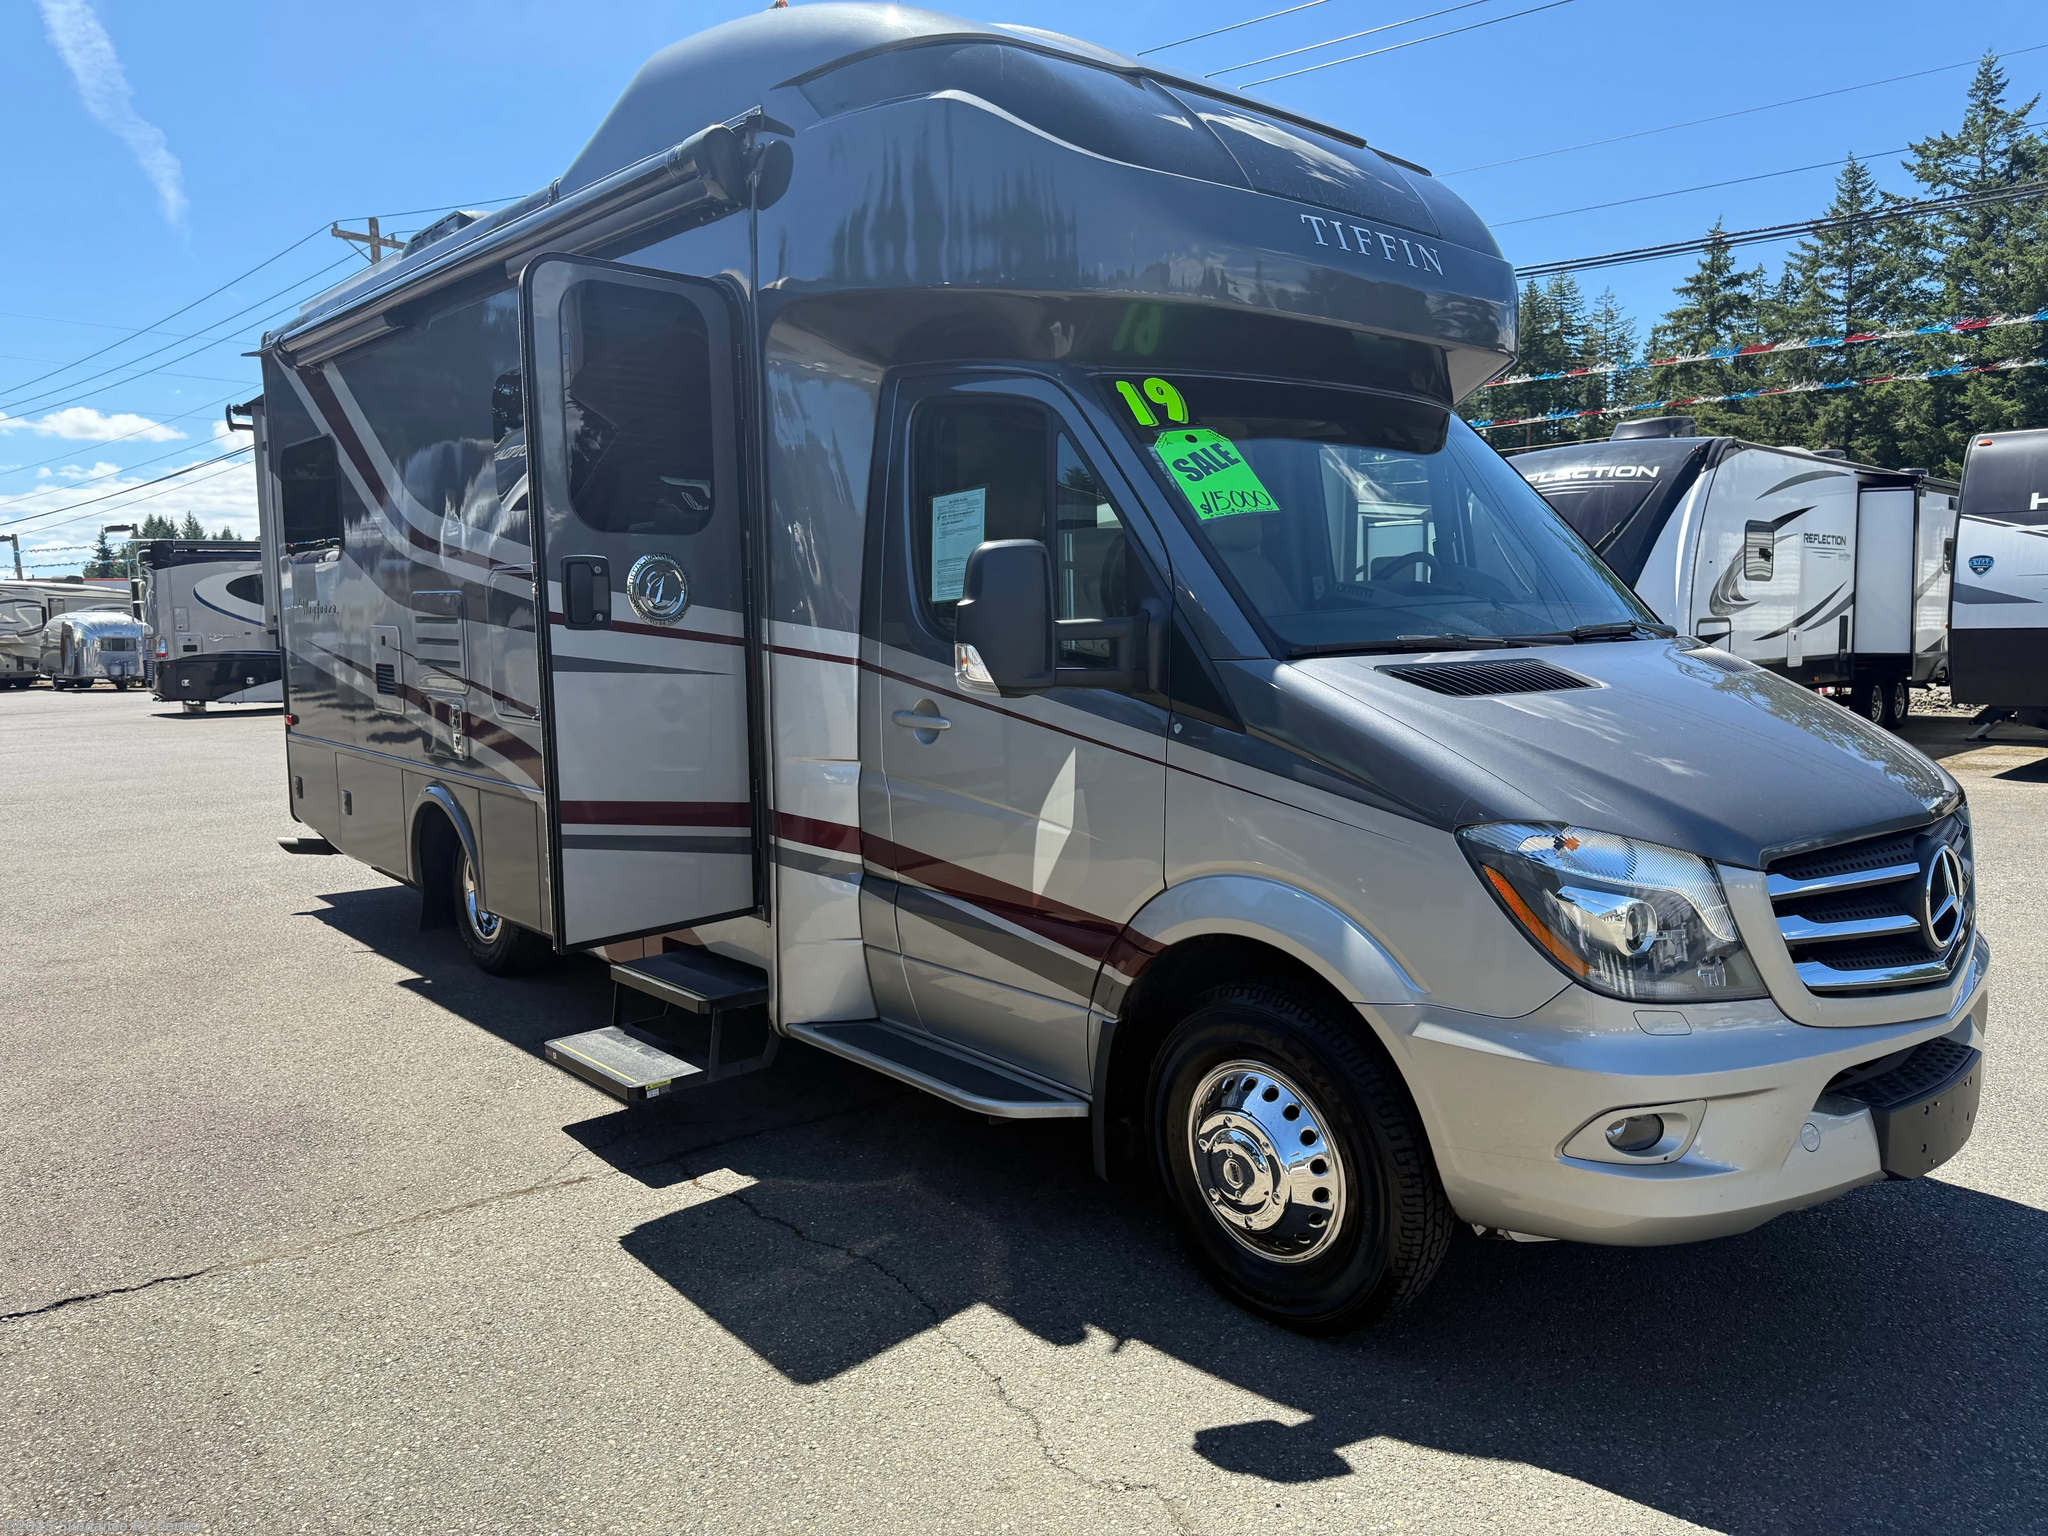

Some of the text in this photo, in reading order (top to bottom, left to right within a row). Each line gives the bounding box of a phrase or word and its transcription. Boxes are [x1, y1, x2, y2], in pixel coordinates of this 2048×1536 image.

[1300, 214, 1443, 276] TIFFIN
[1115, 377, 1188, 426] 19
[1172, 443, 1241, 482] SALE
[1803, 532, 1847, 546] REFLECTION
